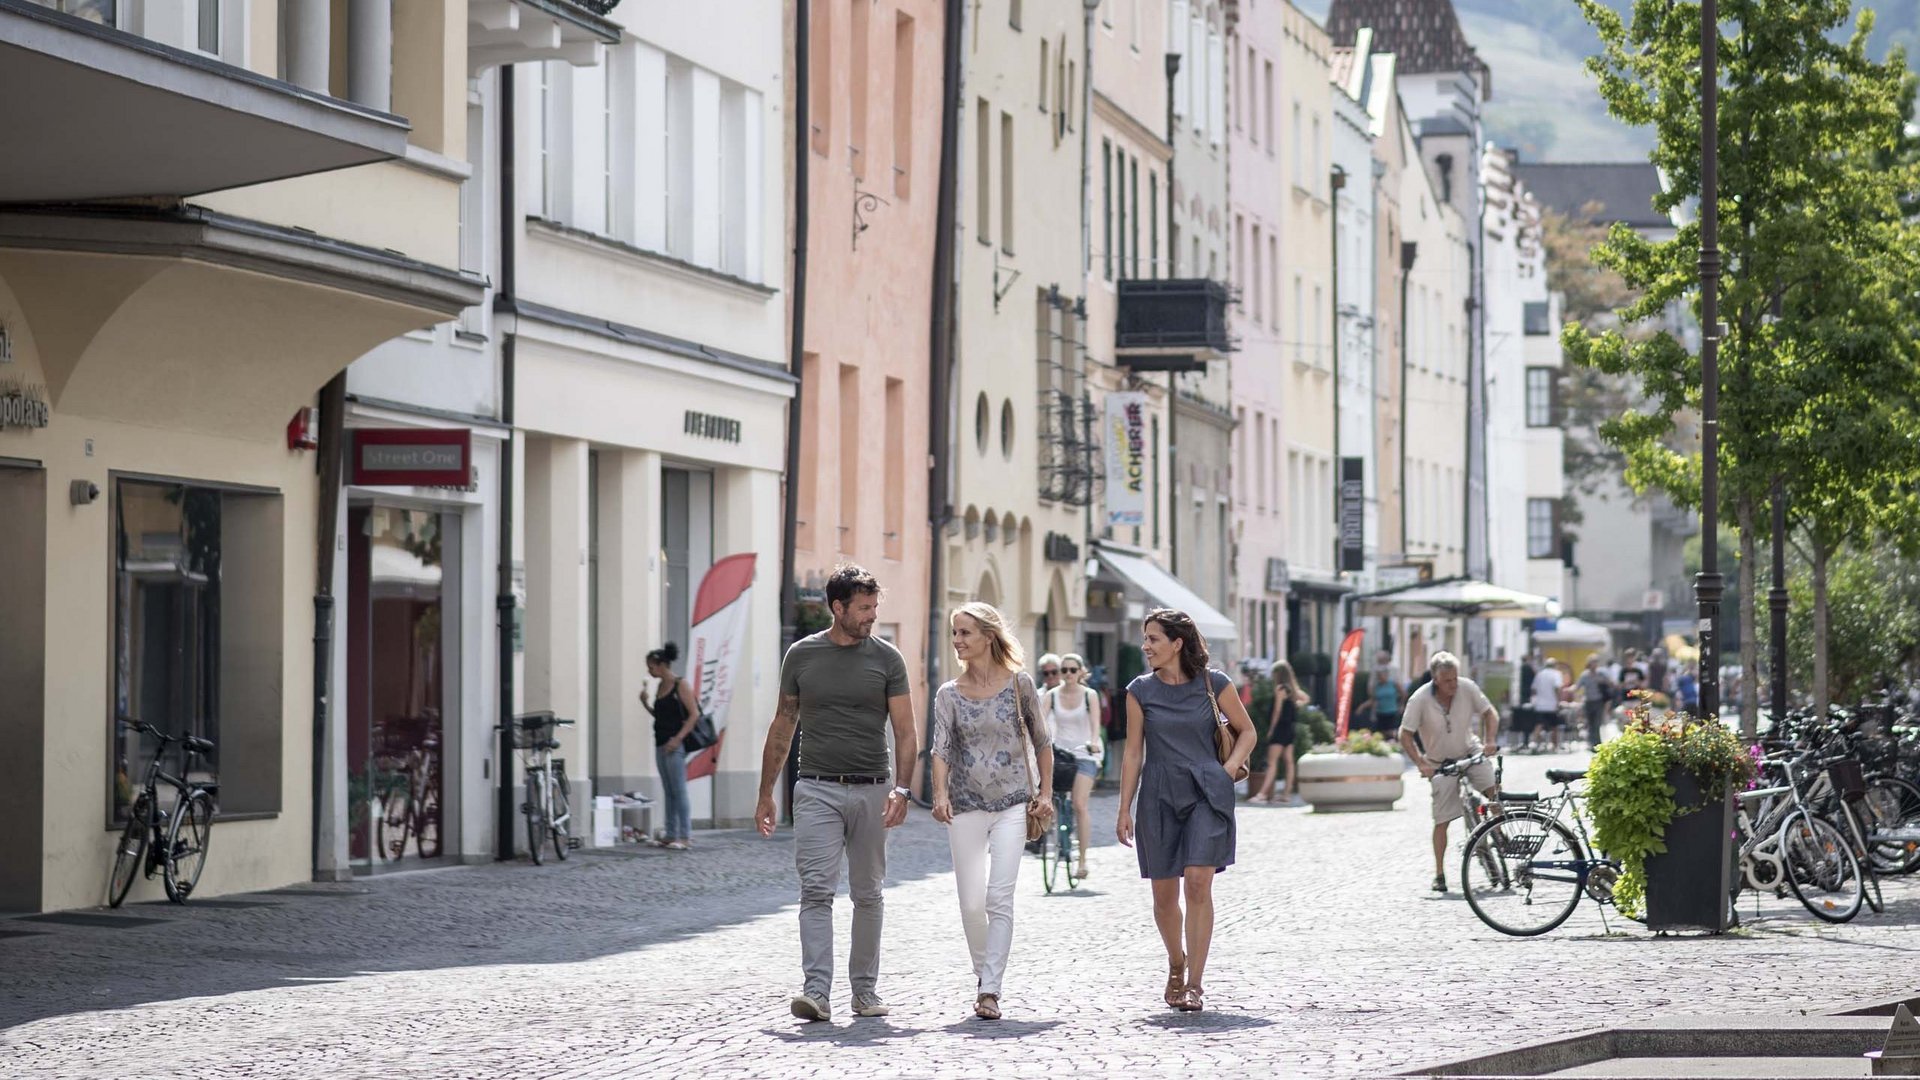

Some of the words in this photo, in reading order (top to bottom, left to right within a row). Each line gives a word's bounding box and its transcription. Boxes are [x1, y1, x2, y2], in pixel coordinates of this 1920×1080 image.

[0, 393, 48, 431] polare
[368, 450, 418, 465] Street
[422, 450, 456, 464] One
[1127, 402, 1143, 492] ACHERER
